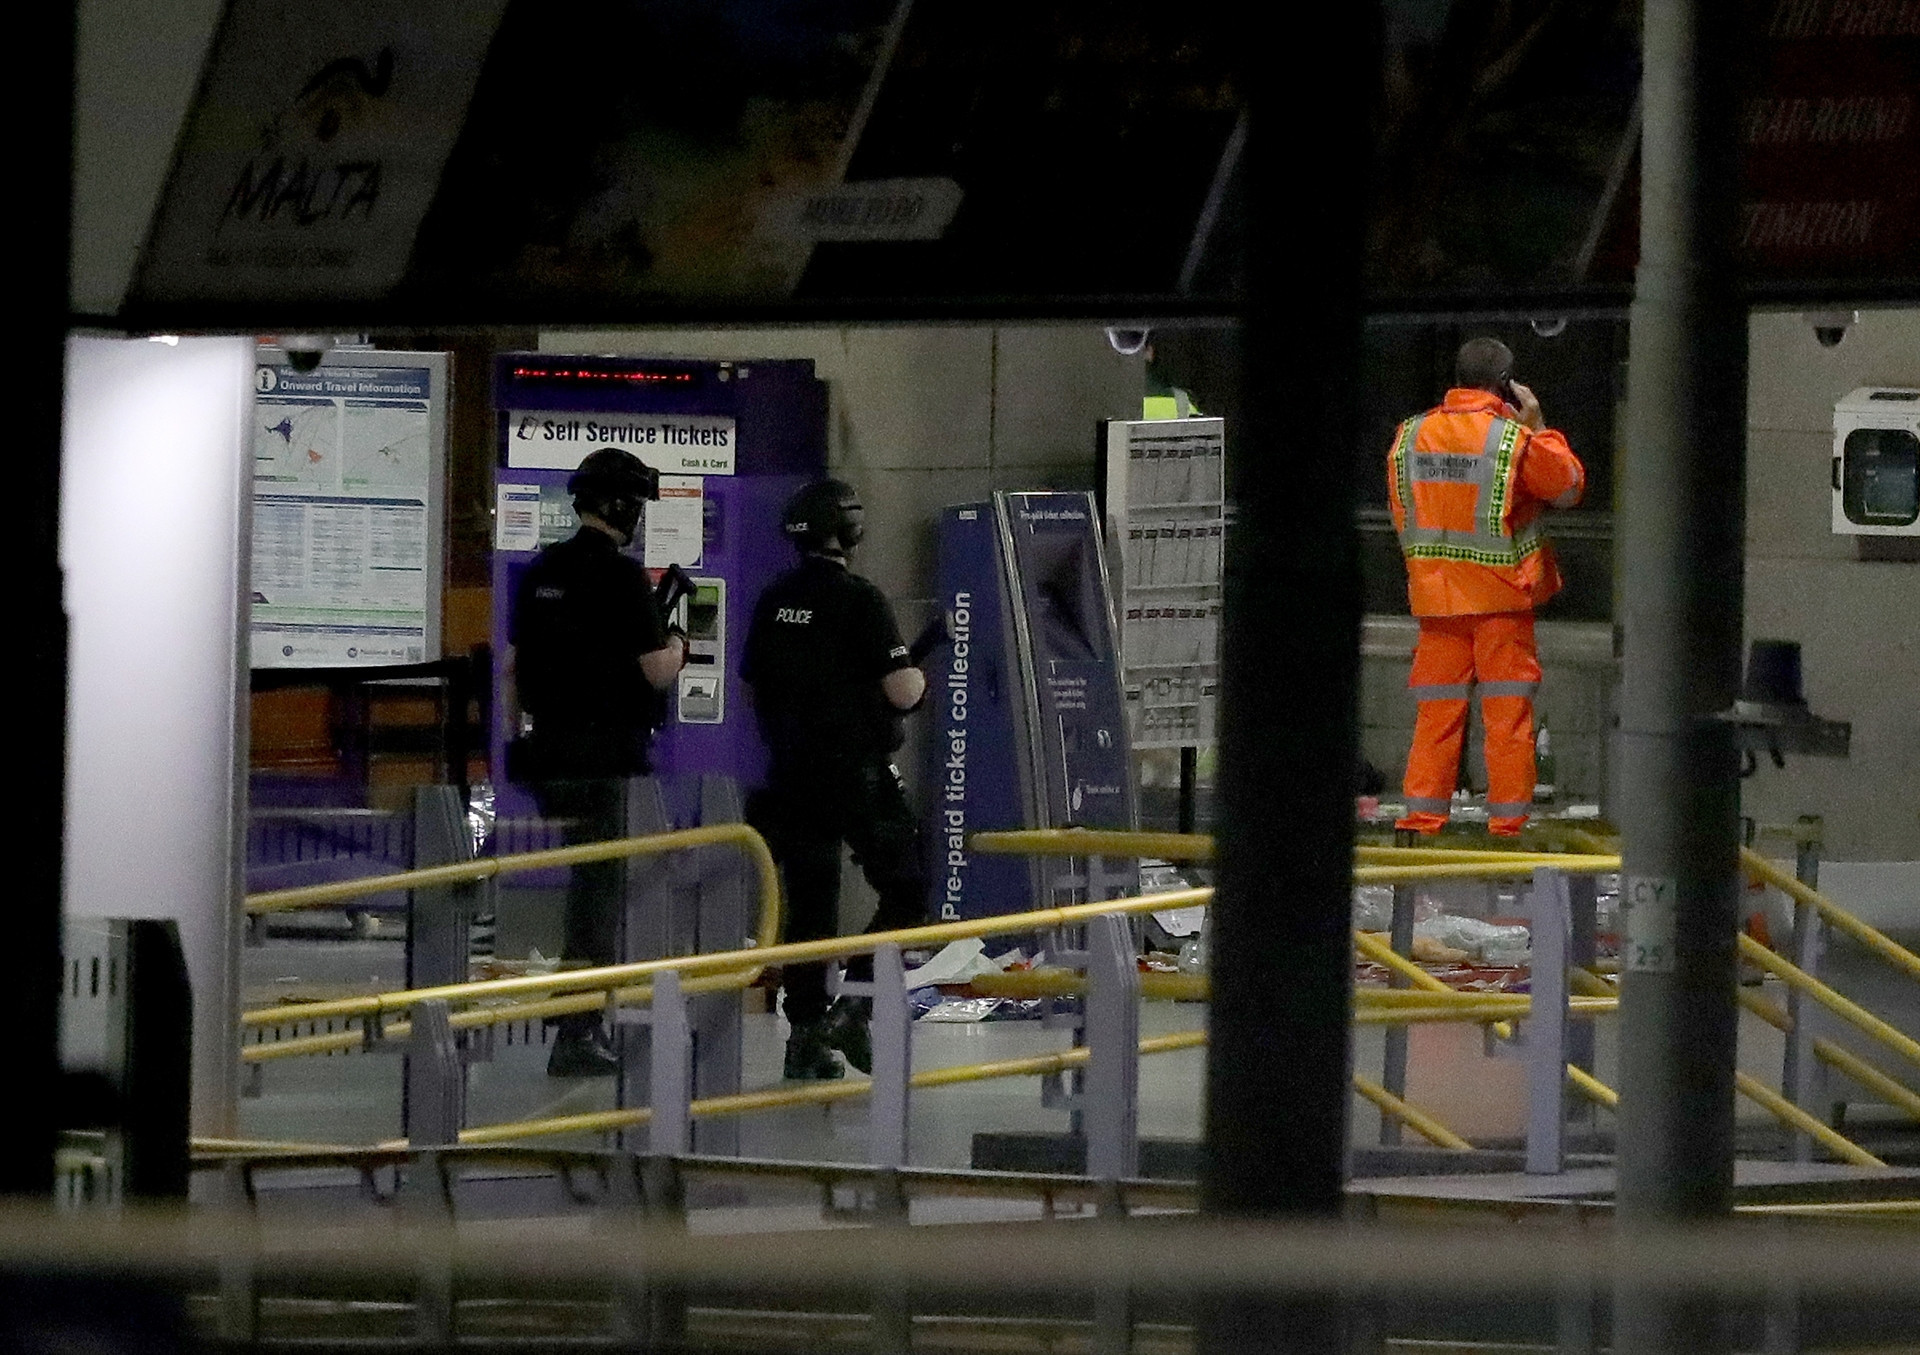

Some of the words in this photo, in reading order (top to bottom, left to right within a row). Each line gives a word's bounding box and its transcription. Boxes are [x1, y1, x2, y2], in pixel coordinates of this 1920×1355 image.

[214, 157, 382, 233] MALTA
[280, 379, 322, 392] Onward
[325, 381, 357, 393] Travel
[358, 383, 421, 395] Information
[543, 421, 579, 441] Self
[586, 422, 657, 444] Service
[661, 424, 729, 447] Tickets
[681, 458, 700, 468] Cash
[710, 459, 728, 469] Card
[775, 608, 813, 624] POLICE
[948, 591, 971, 722] collection
[946, 728, 967, 802] ticket
[942, 809, 967, 921] Pre-paid
